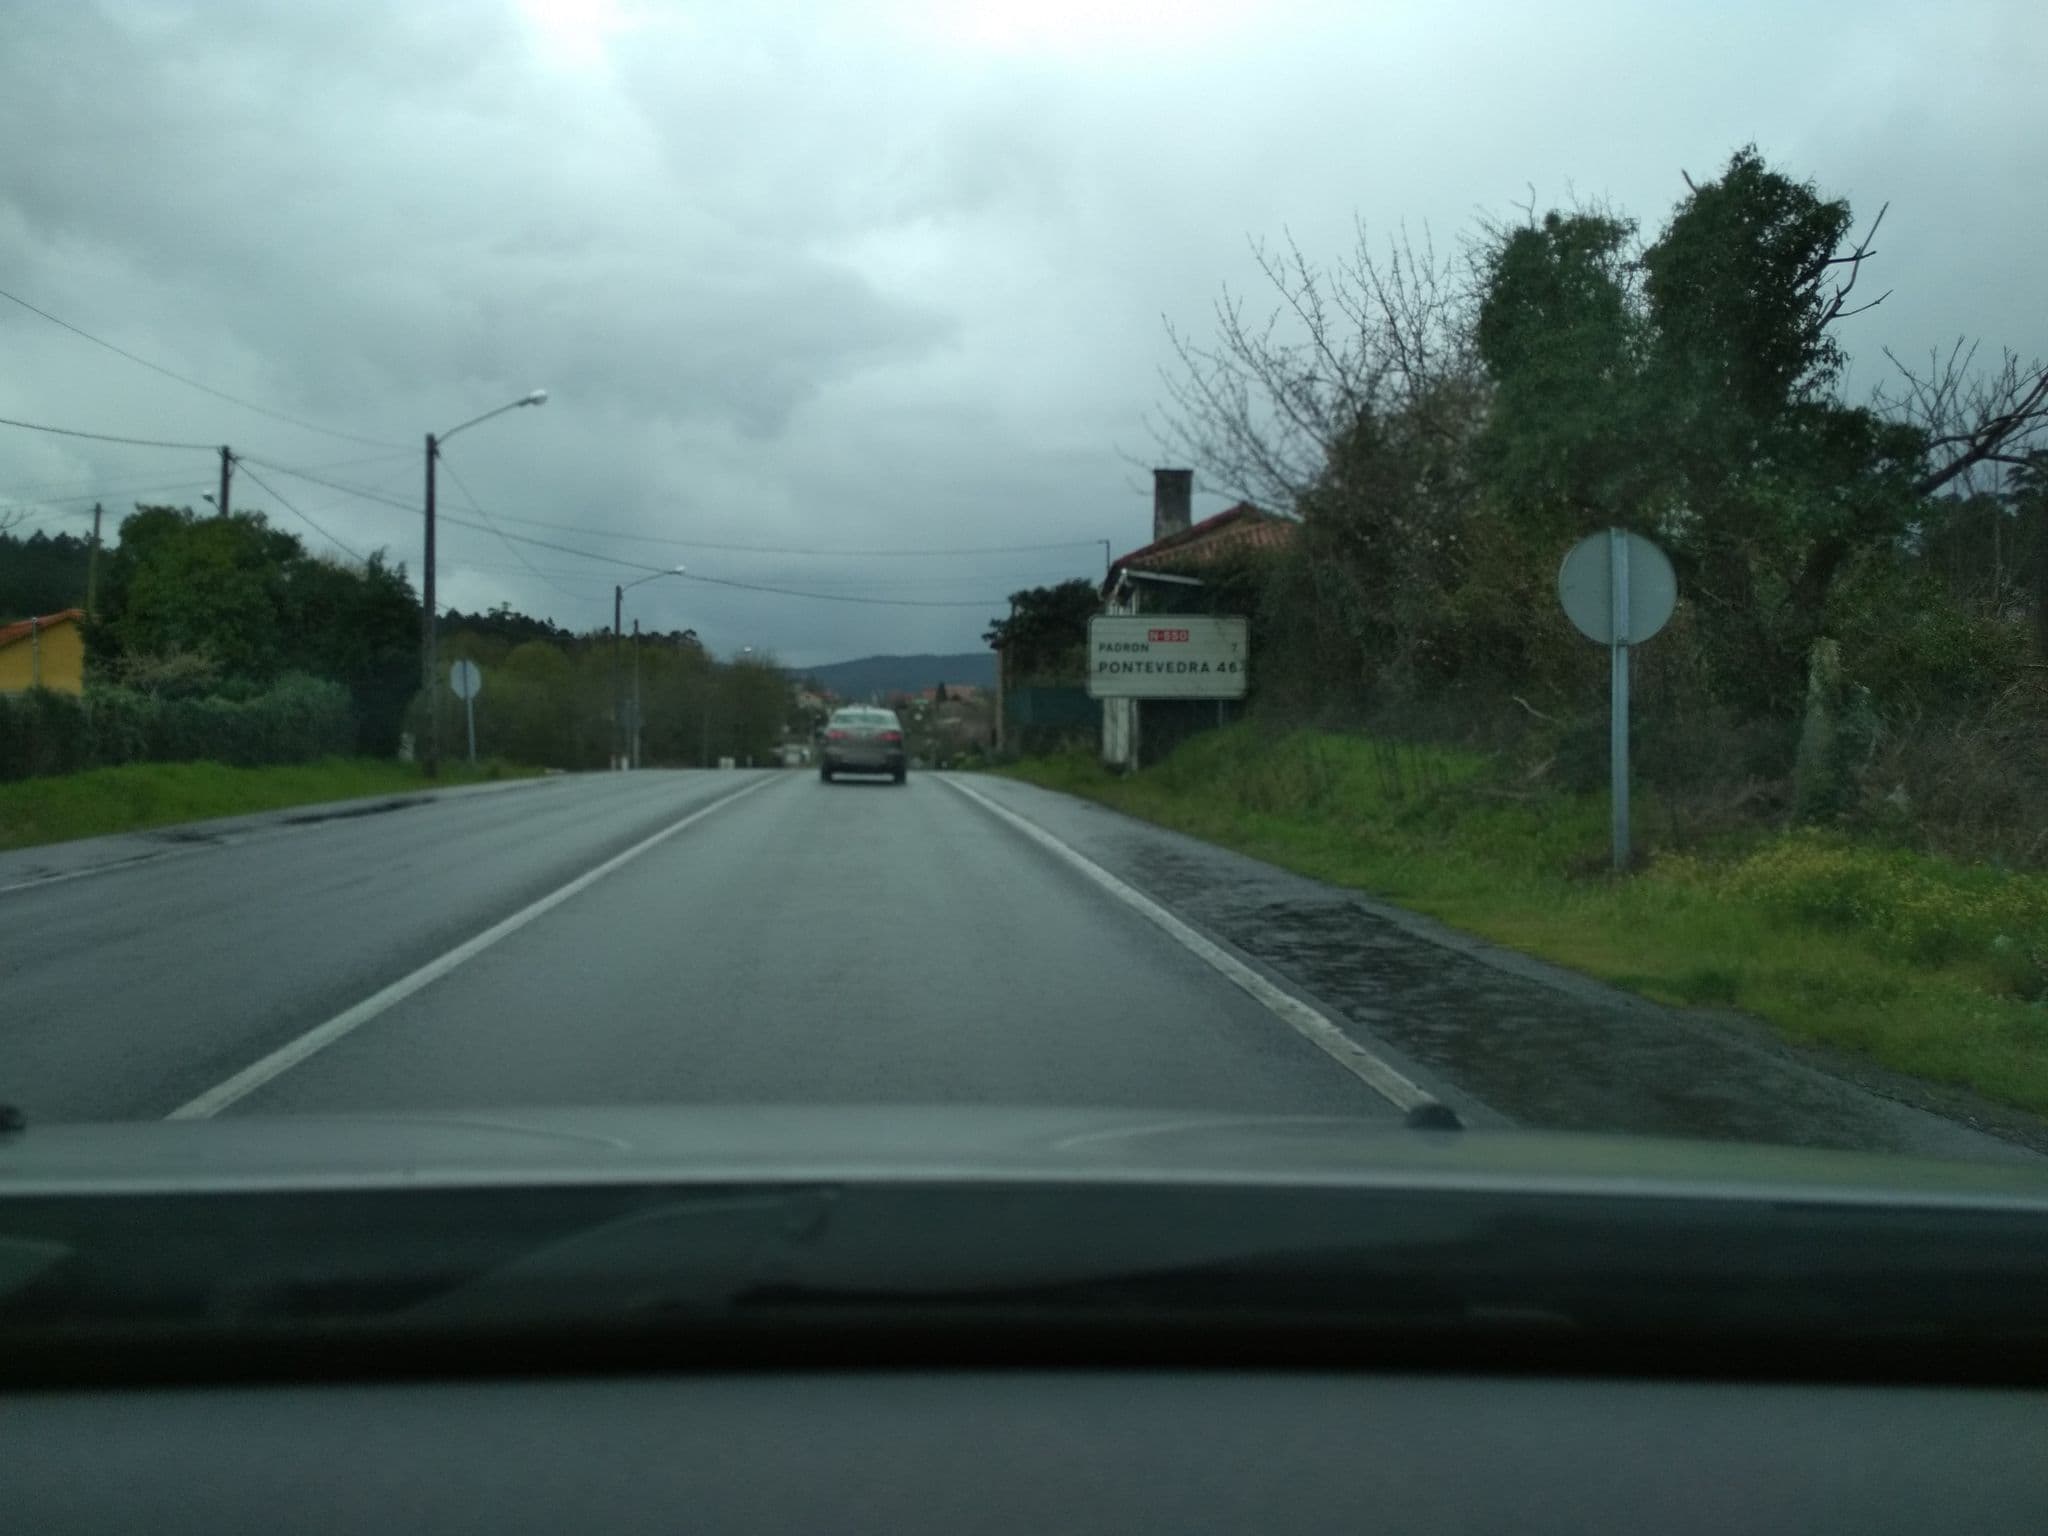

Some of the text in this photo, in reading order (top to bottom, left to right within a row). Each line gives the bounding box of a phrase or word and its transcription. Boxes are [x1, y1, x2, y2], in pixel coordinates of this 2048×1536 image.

[1099, 642, 1149, 652] PADRON
[1099, 661, 1238, 673] PONTEVEDRA 46
